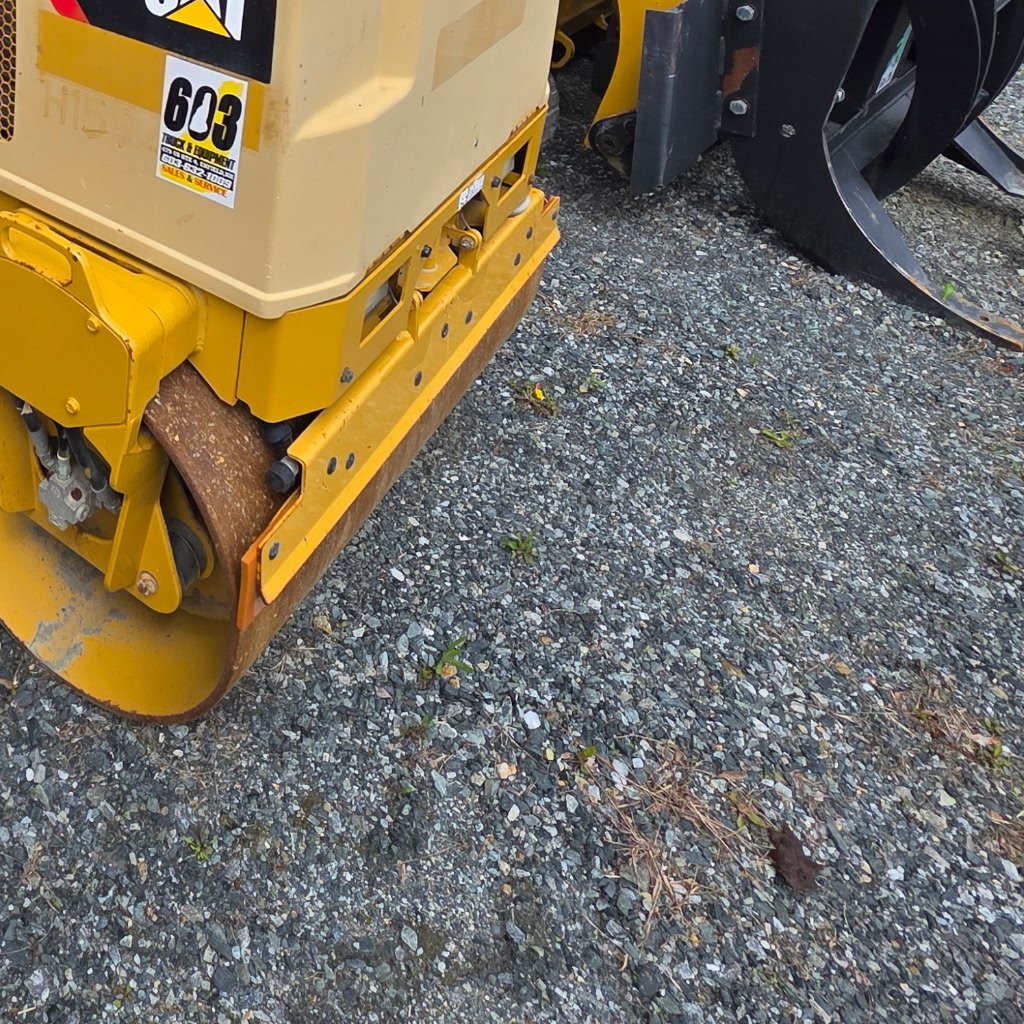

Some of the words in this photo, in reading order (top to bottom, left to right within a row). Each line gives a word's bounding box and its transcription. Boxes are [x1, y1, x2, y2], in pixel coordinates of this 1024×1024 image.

[163, 76, 242, 152] 603
[162, 133, 185, 151] TRUCK
[194, 145, 235, 170] EQUIPMENT
[161, 164, 184, 179] SALES
[187, 175, 192, 183] &
[194, 178, 228, 197] SERVICE
